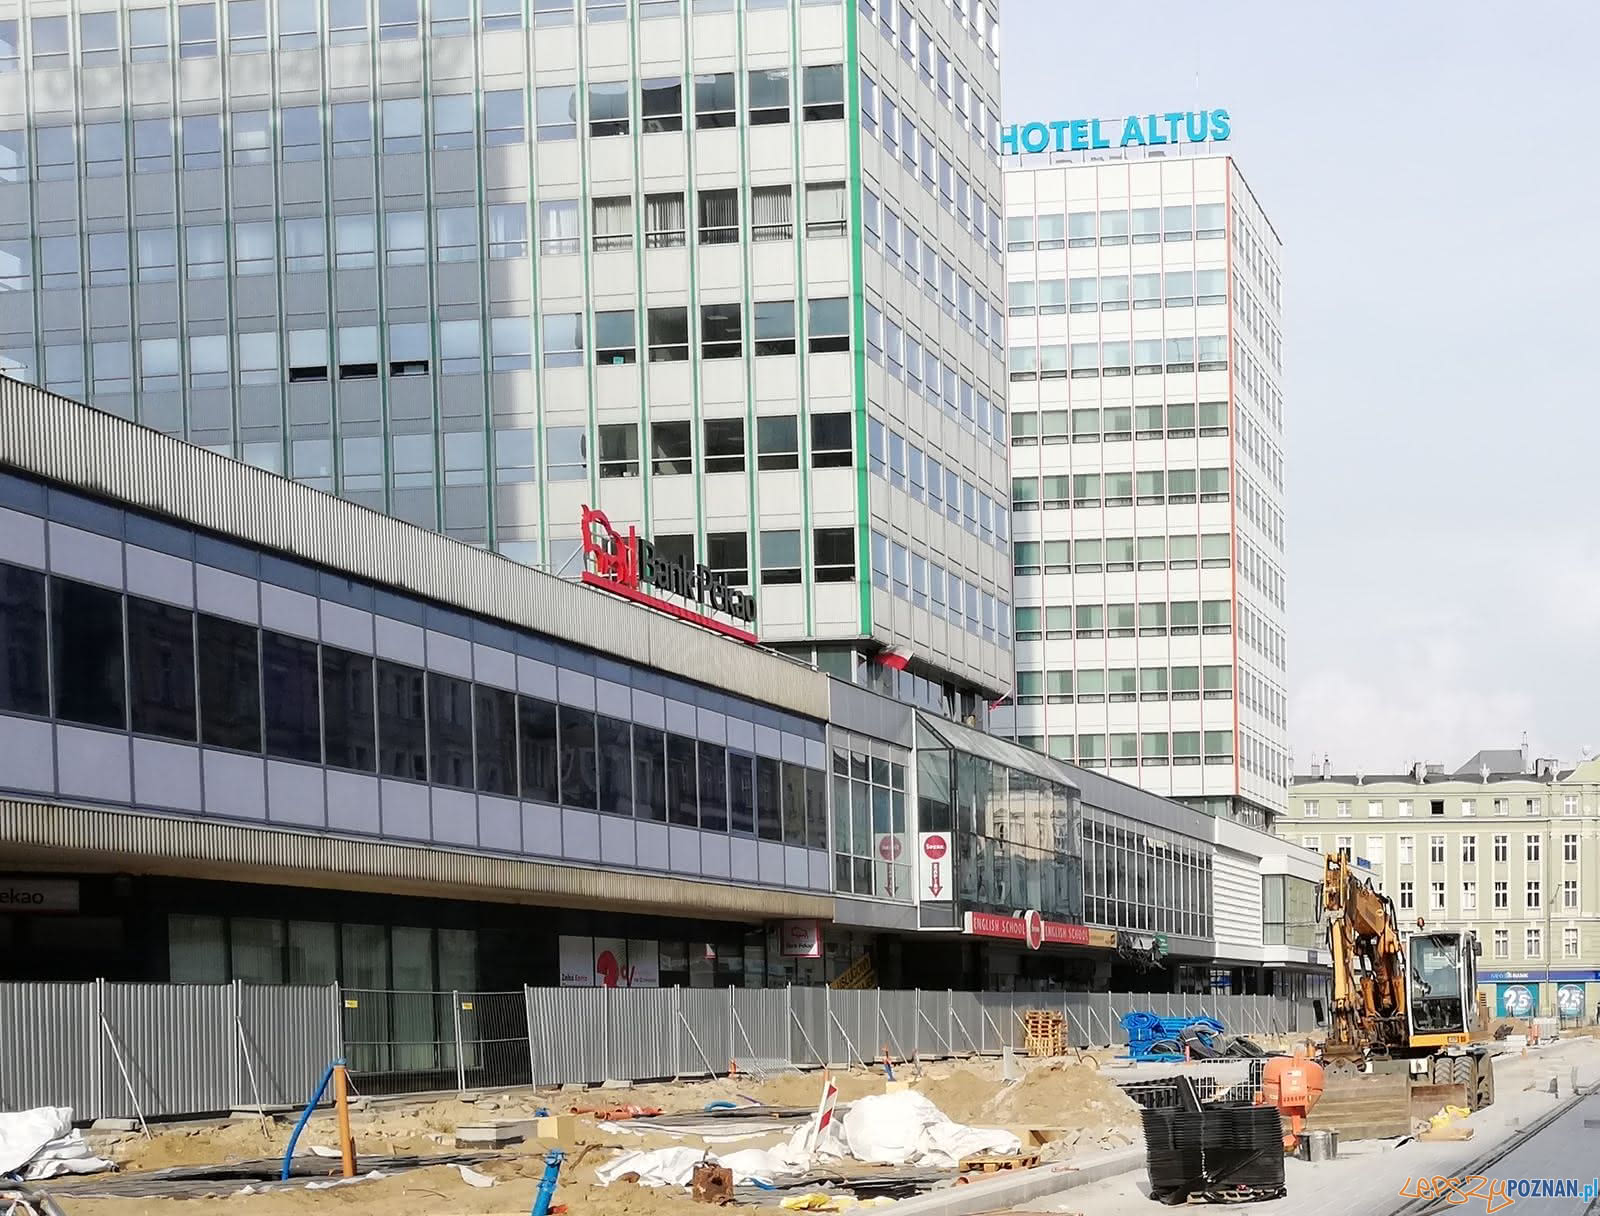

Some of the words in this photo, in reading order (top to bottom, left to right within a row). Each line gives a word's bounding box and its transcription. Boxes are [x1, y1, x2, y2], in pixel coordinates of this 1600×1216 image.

[1001, 118, 1110, 155] HOTEL
[1120, 108, 1231, 147] ALTUS
[638, 538, 696, 602] Bank
[696, 563, 757, 622] Pekao
[0, 888, 44, 904] ekao
[973, 917, 1000, 932] ENGLISH
[1002, 920, 1026, 936] SCHOOL
[1504, 990, 1531, 1009] 25
[1558, 989, 1584, 1009] 25
